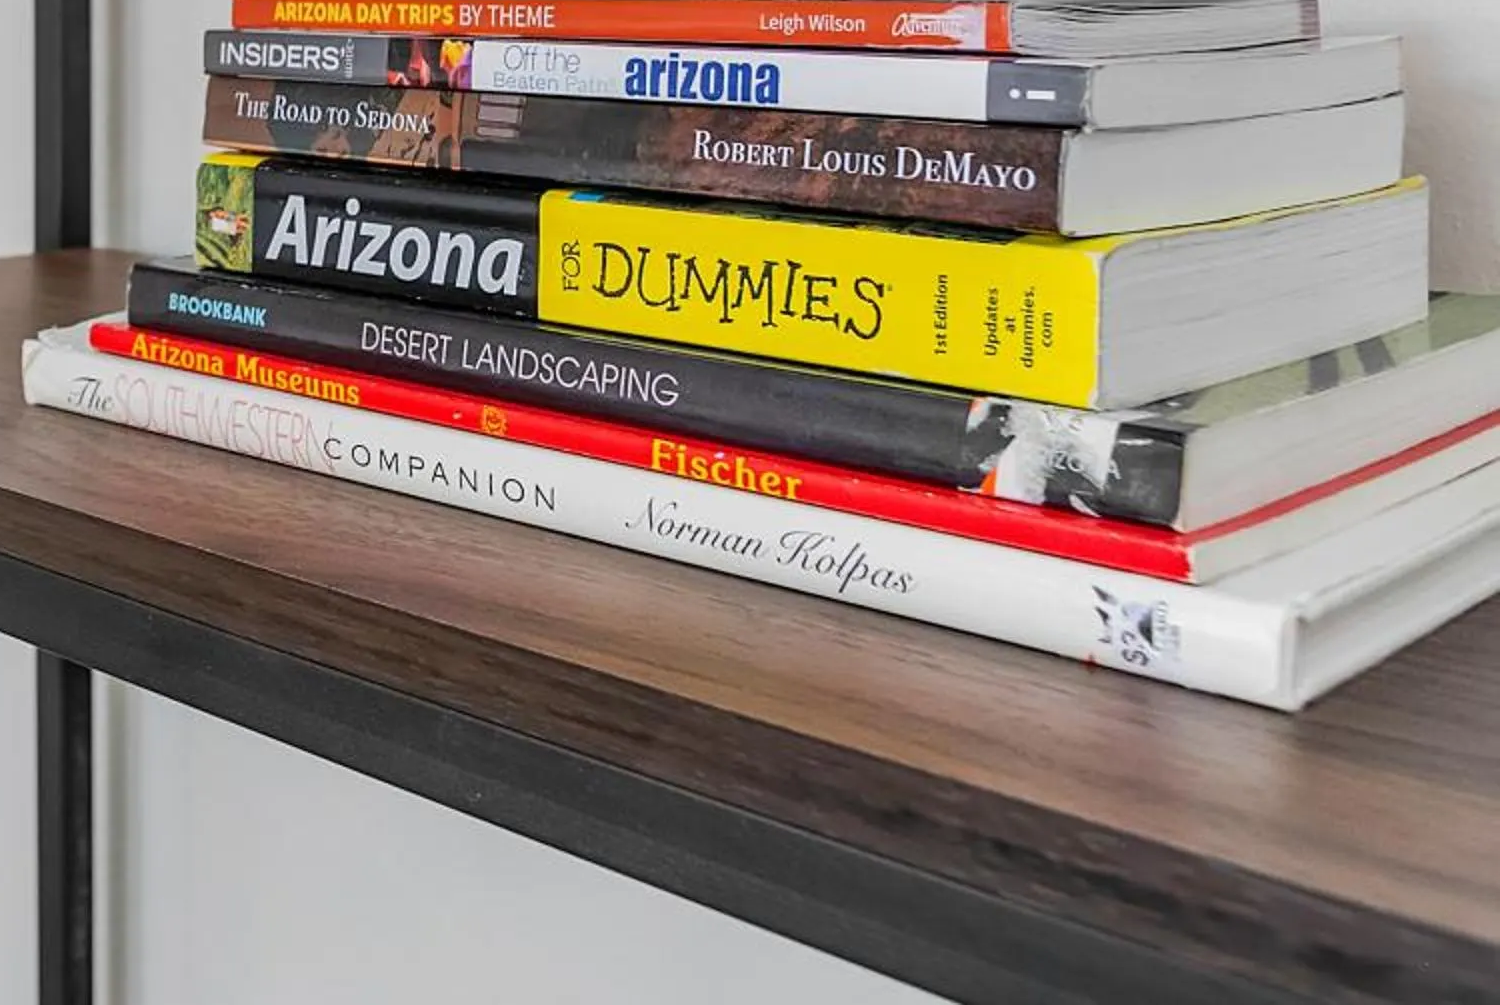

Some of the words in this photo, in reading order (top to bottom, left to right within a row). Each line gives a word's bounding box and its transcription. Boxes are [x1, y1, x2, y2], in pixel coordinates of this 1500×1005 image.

[273, 1, 353, 24] ARIZONA
[357, 3, 395, 24] DAY
[397, 3, 454, 25] TRIPS
[459, 5, 485, 27] BY
[487, 6, 555, 28] THEME
[760, 13, 803, 34] Leigh
[808, 14, 866, 33] Wilson
[493, 71, 560, 92] Beaten
[503, 44, 538, 71] Off
[545, 46, 581, 74] the
[625, 52, 780, 104] arizona
[235, 92, 270, 121] THE
[273, 96, 323, 126] ROAD
[326, 107, 350, 127] TO
[356, 104, 431, 135] SEDONA
[692, 130, 795, 169] ROBERT
[801, 139, 887, 176] LOUIS
[265, 194, 526, 297] Arizona
[168, 293, 267, 328] BROOKBANK
[562, 238, 581, 292] FOR
[592, 242, 886, 340] DUMMIES
[933, 274, 949, 330] Edition
[933, 333, 948, 355] 1st
[983, 287, 1001, 356] Updates
[1004, 316, 1016, 333] at
[1042, 312, 1053, 347] com
[131, 332, 224, 376] Arizona
[235, 352, 361, 406] Museums
[360, 322, 453, 366] DESERT
[462, 338, 680, 407] LANDSCAPING
[67, 375, 114, 413] The
[113, 372, 336, 473] SOUTHWESTERN
[323, 437, 557, 511] COMPANION
[650, 438, 804, 500] Fischer
[624, 496, 765, 558] Norman
[775, 530, 916, 597] Kolpas
